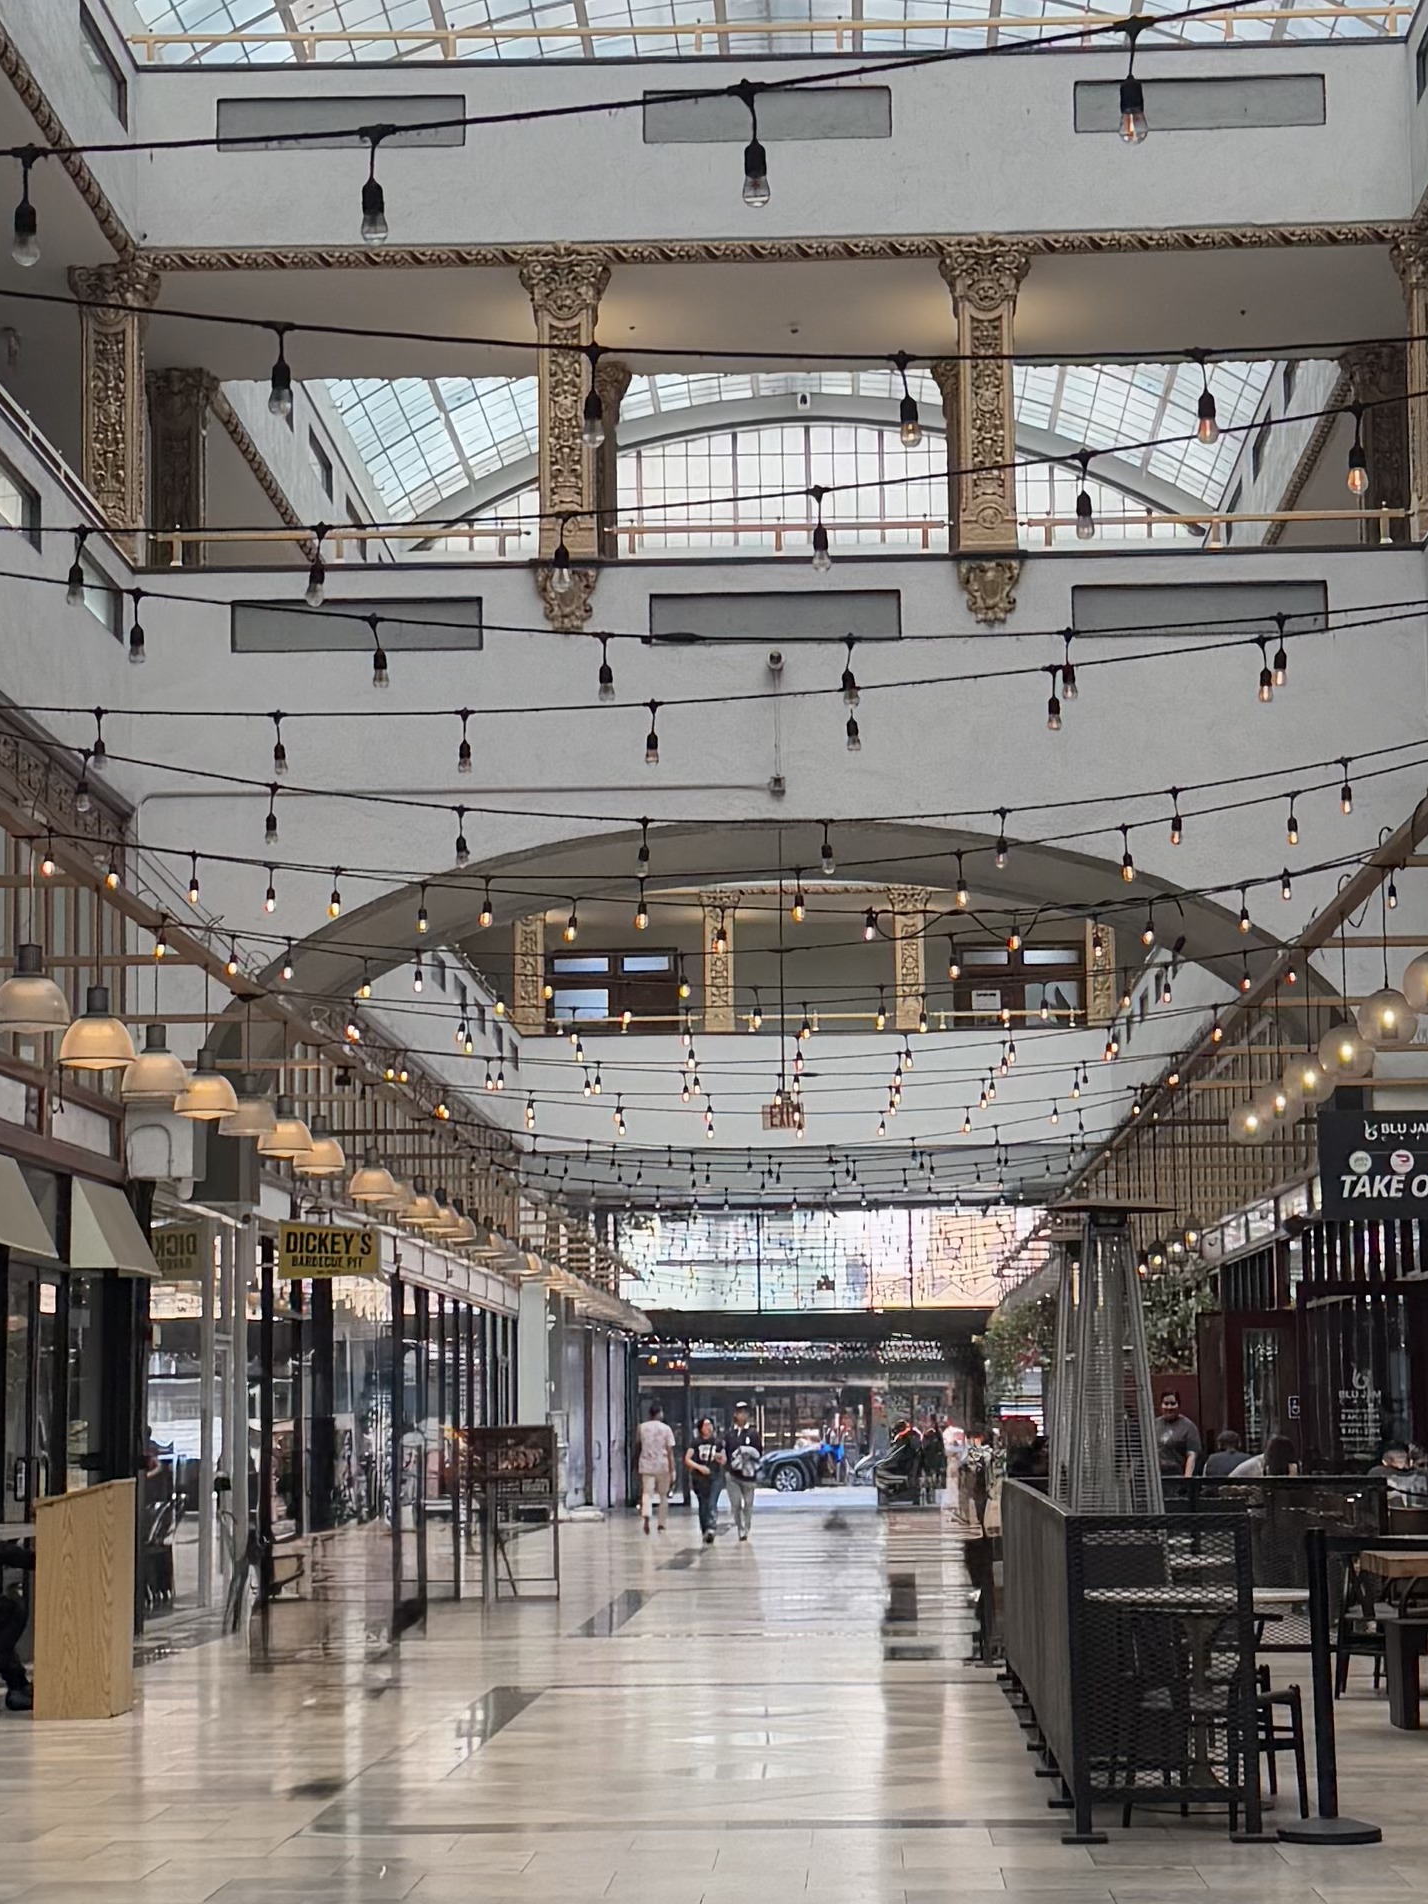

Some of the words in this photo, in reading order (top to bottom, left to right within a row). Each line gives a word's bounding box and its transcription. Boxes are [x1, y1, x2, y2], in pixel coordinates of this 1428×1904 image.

[1381, 1122, 1407, 1134] BLU
[1340, 1174, 1407, 1199] TAKE
[285, 1231, 372, 1256] DICKEY'S
